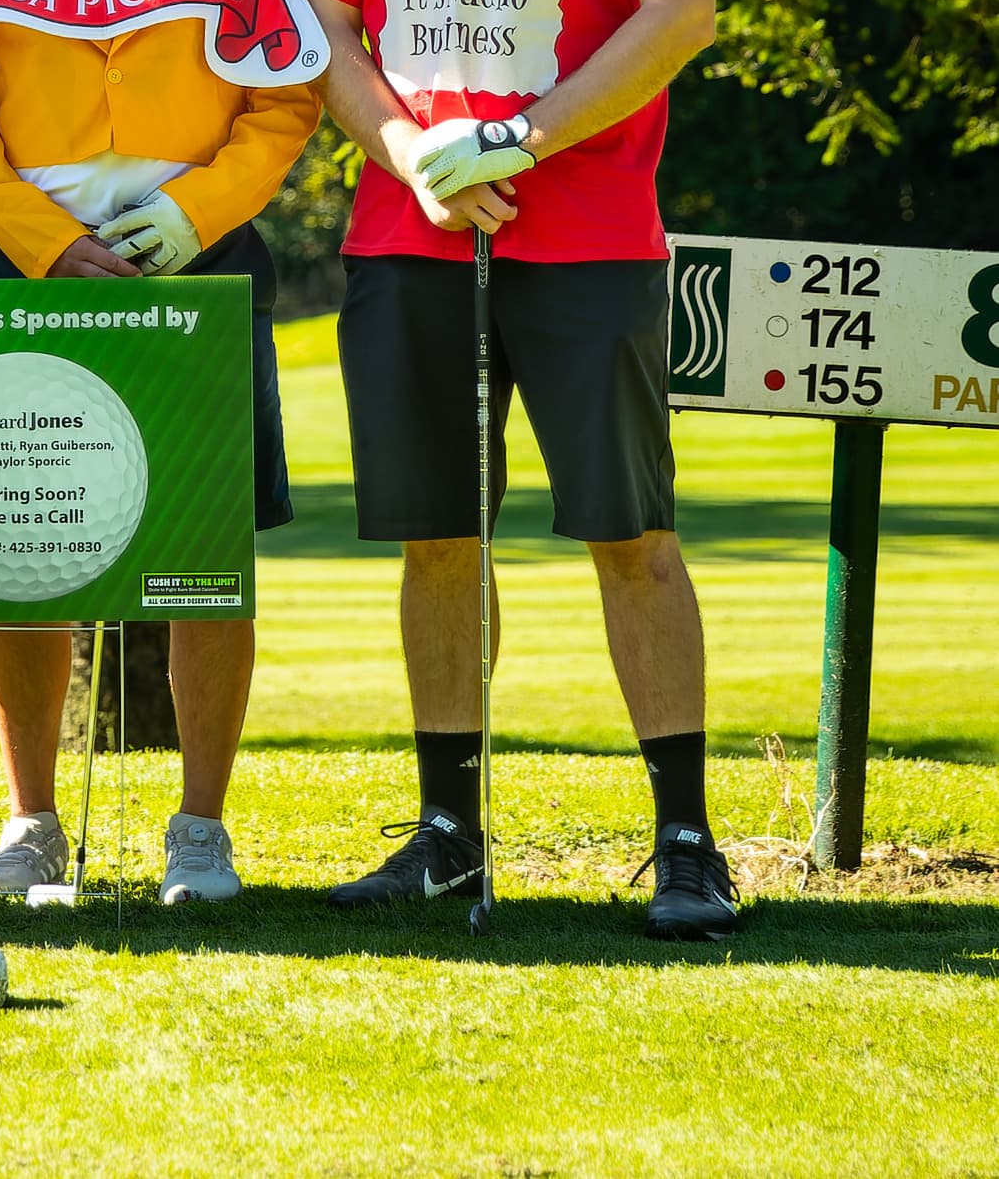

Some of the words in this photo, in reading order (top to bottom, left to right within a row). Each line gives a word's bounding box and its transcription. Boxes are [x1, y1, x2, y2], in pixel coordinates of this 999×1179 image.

[802, 254, 880, 297] 212
[10, 306, 159, 335] Sponsored
[165, 305, 200, 335] by
[801, 308, 875, 350] 174
[479, 333, 487, 355] PING
[798, 363, 883, 406] 155
[29, 412, 83, 430] Jones
[19, 441, 48, 453] Ryan
[51, 440, 115, 452] Guiberson,
[28, 456, 71, 468] Sporcic
[34, 487, 86, 501] Soon?
[11, 513, 32, 524] us
[34, 513, 43, 524] a
[48, 509, 84, 524] Call!
[9, 541, 102, 553] 425-391-0830
[147, 578, 170, 587] CUSH
[171, 578, 180, 586] IT
[182, 578, 193, 586] TO
[195, 578, 211, 586] THE
[213, 578, 236, 586] LIMIT
[430, 814, 457, 833] NIKE
[676, 829, 702, 844] NIKE
